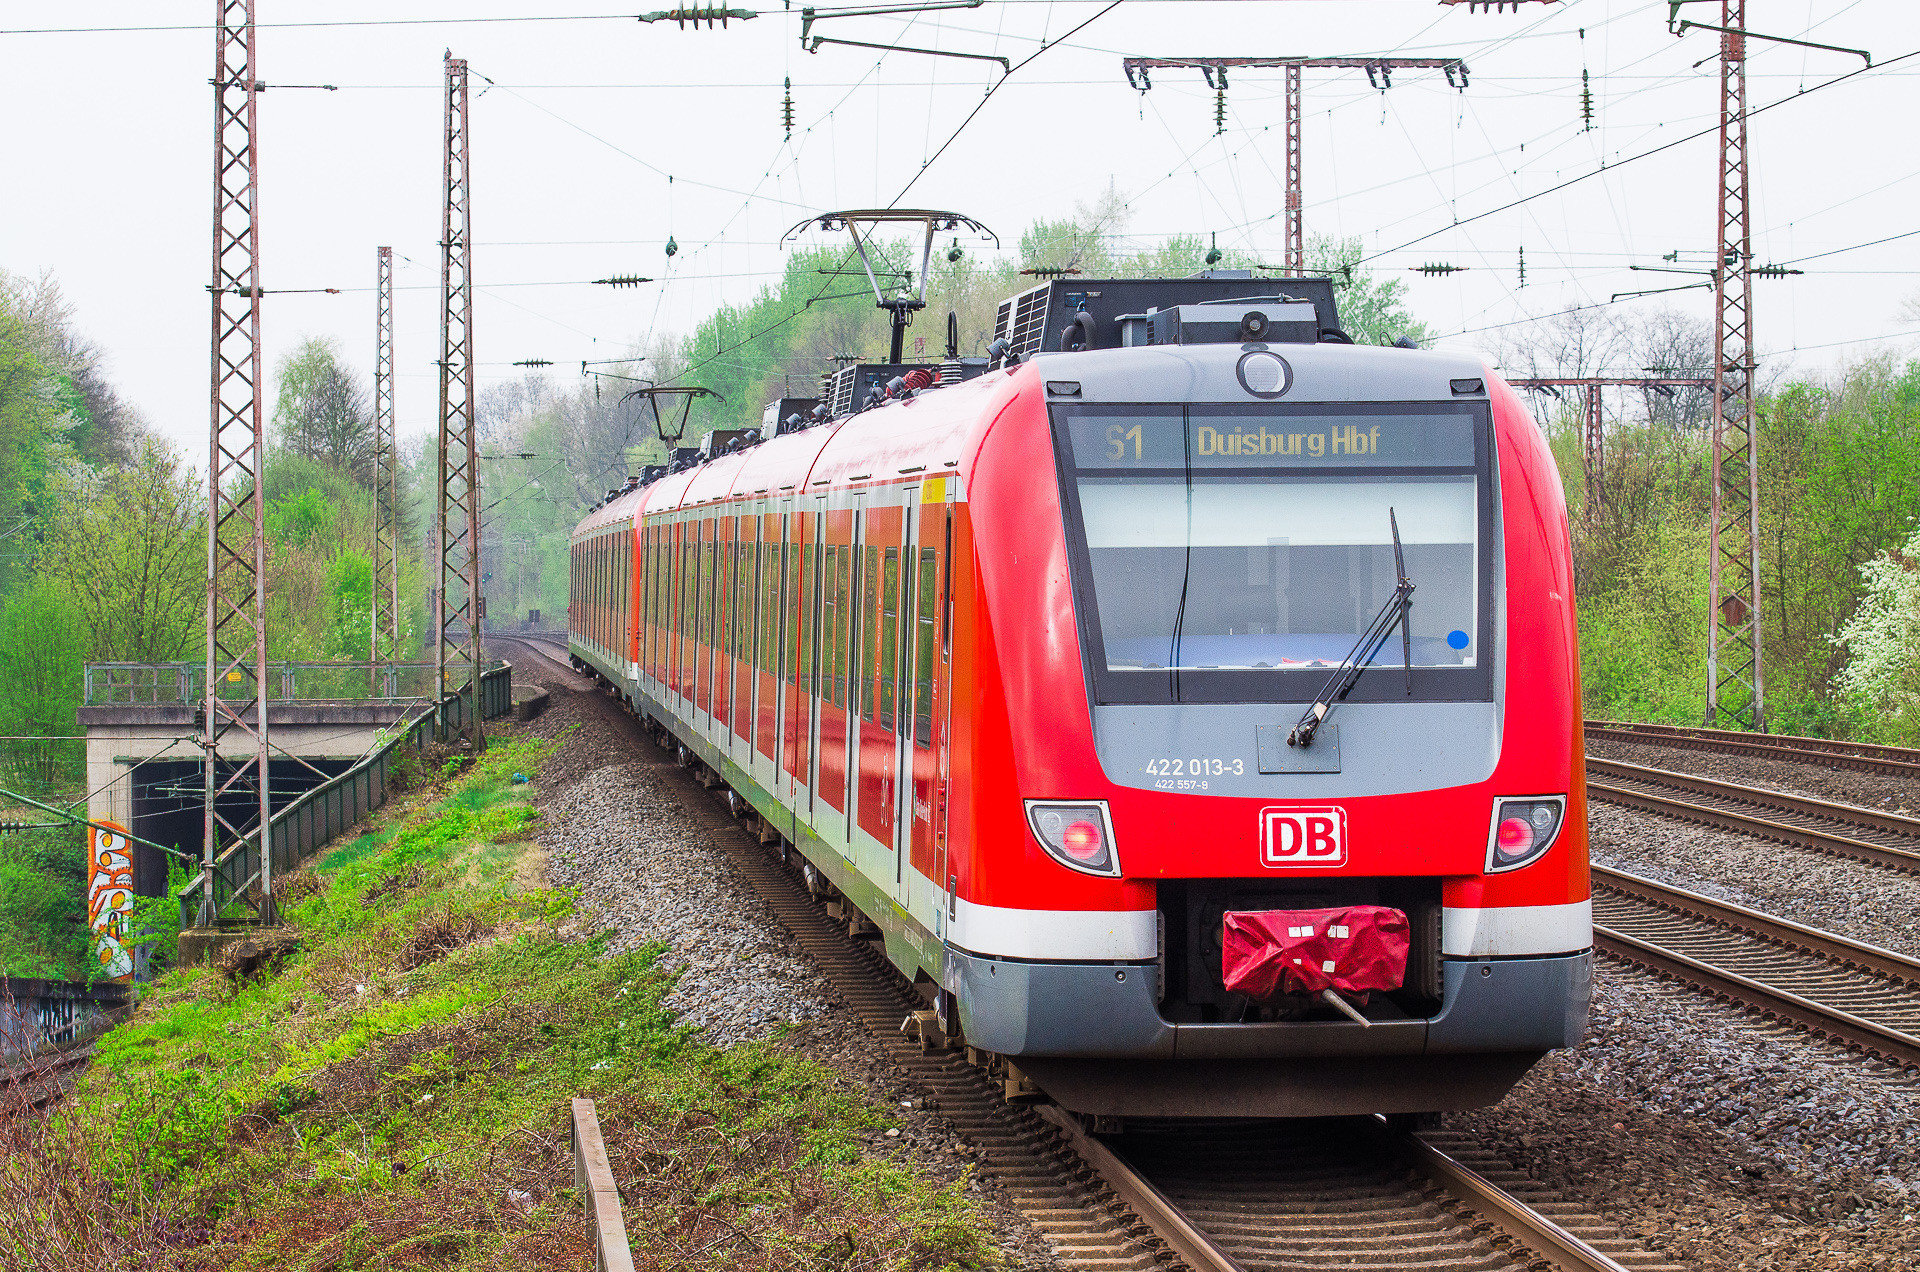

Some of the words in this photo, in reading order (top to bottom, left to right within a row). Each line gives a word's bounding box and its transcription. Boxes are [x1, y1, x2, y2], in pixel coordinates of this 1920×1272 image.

[1105, 424, 1143, 460] S1
[1197, 425, 1325, 458] Duisburg
[1332, 425, 1381, 456] Hbf
[1145, 758, 1184, 776] 422
[1189, 758, 1244, 776] 013-3
[1154, 779, 1175, 790] 422
[1176, 780, 1209, 791] 557-9
[1270, 815, 1338, 858] DB
